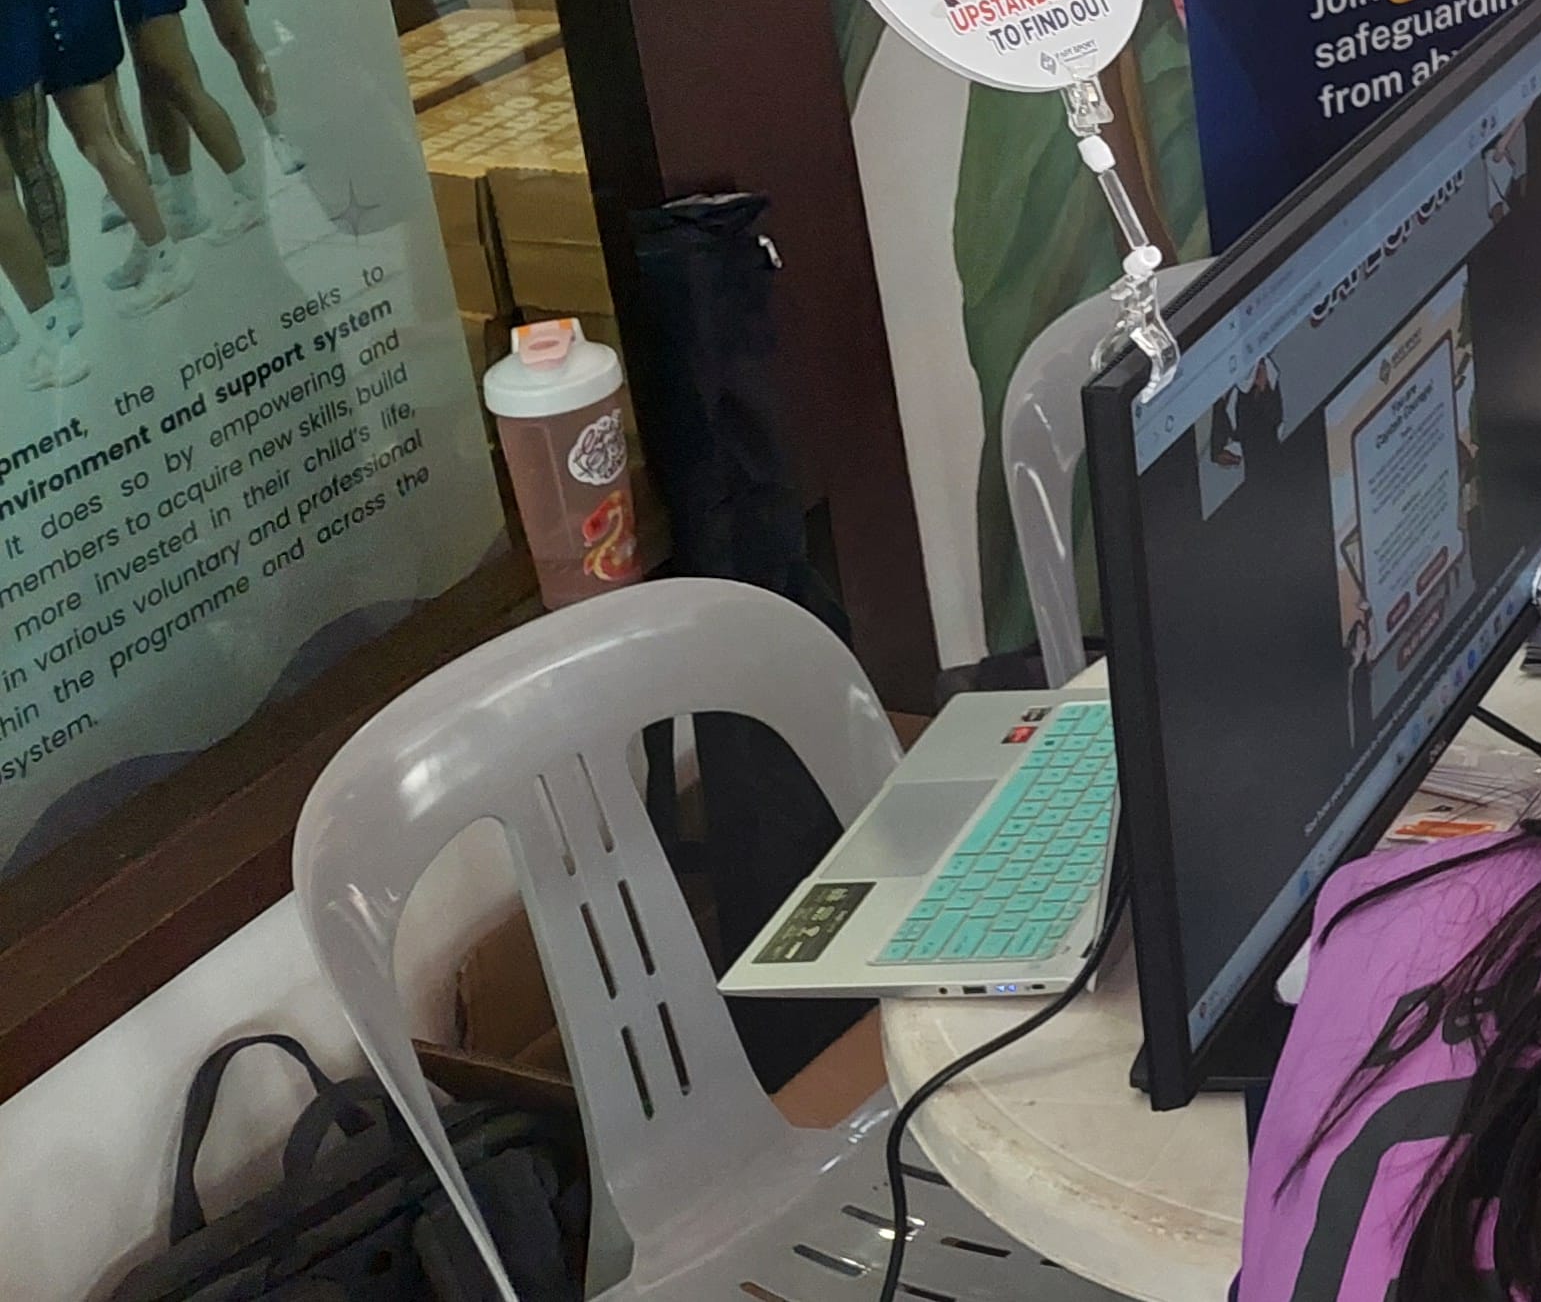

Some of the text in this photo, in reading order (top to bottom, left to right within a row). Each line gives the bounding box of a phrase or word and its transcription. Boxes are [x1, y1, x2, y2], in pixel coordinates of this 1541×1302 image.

[989, 24, 1022, 51] TO
[1019, 6, 1070, 41] FIND
[1319, 70, 1403, 118] from
[115, 384, 156, 417] the
[180, 327, 259, 390] project
[279, 287, 342, 330] seeks
[362, 265, 385, 287] to
[160, 391, 207, 434] and
[214, 342, 306, 405] support
[313, 299, 393, 353] system
[4, 328, 400, 560] It does so by empowering and
[14, 402, 417, 642] more invested in their child's life,
[125, 511, 151, 536] to
[157, 458, 244, 518] acquire
[248, 428, 294, 467] new
[299, 399, 354, 438] skills,
[356, 361, 409, 406] build
[1, 428, 424, 693] in various voluntary and professional
[52, 669, 95, 704] the
[109, 574, 250, 679] programme
[262, 537, 306, 578] and
[316, 491, 387, 545] across
[396, 465, 430, 497] the
